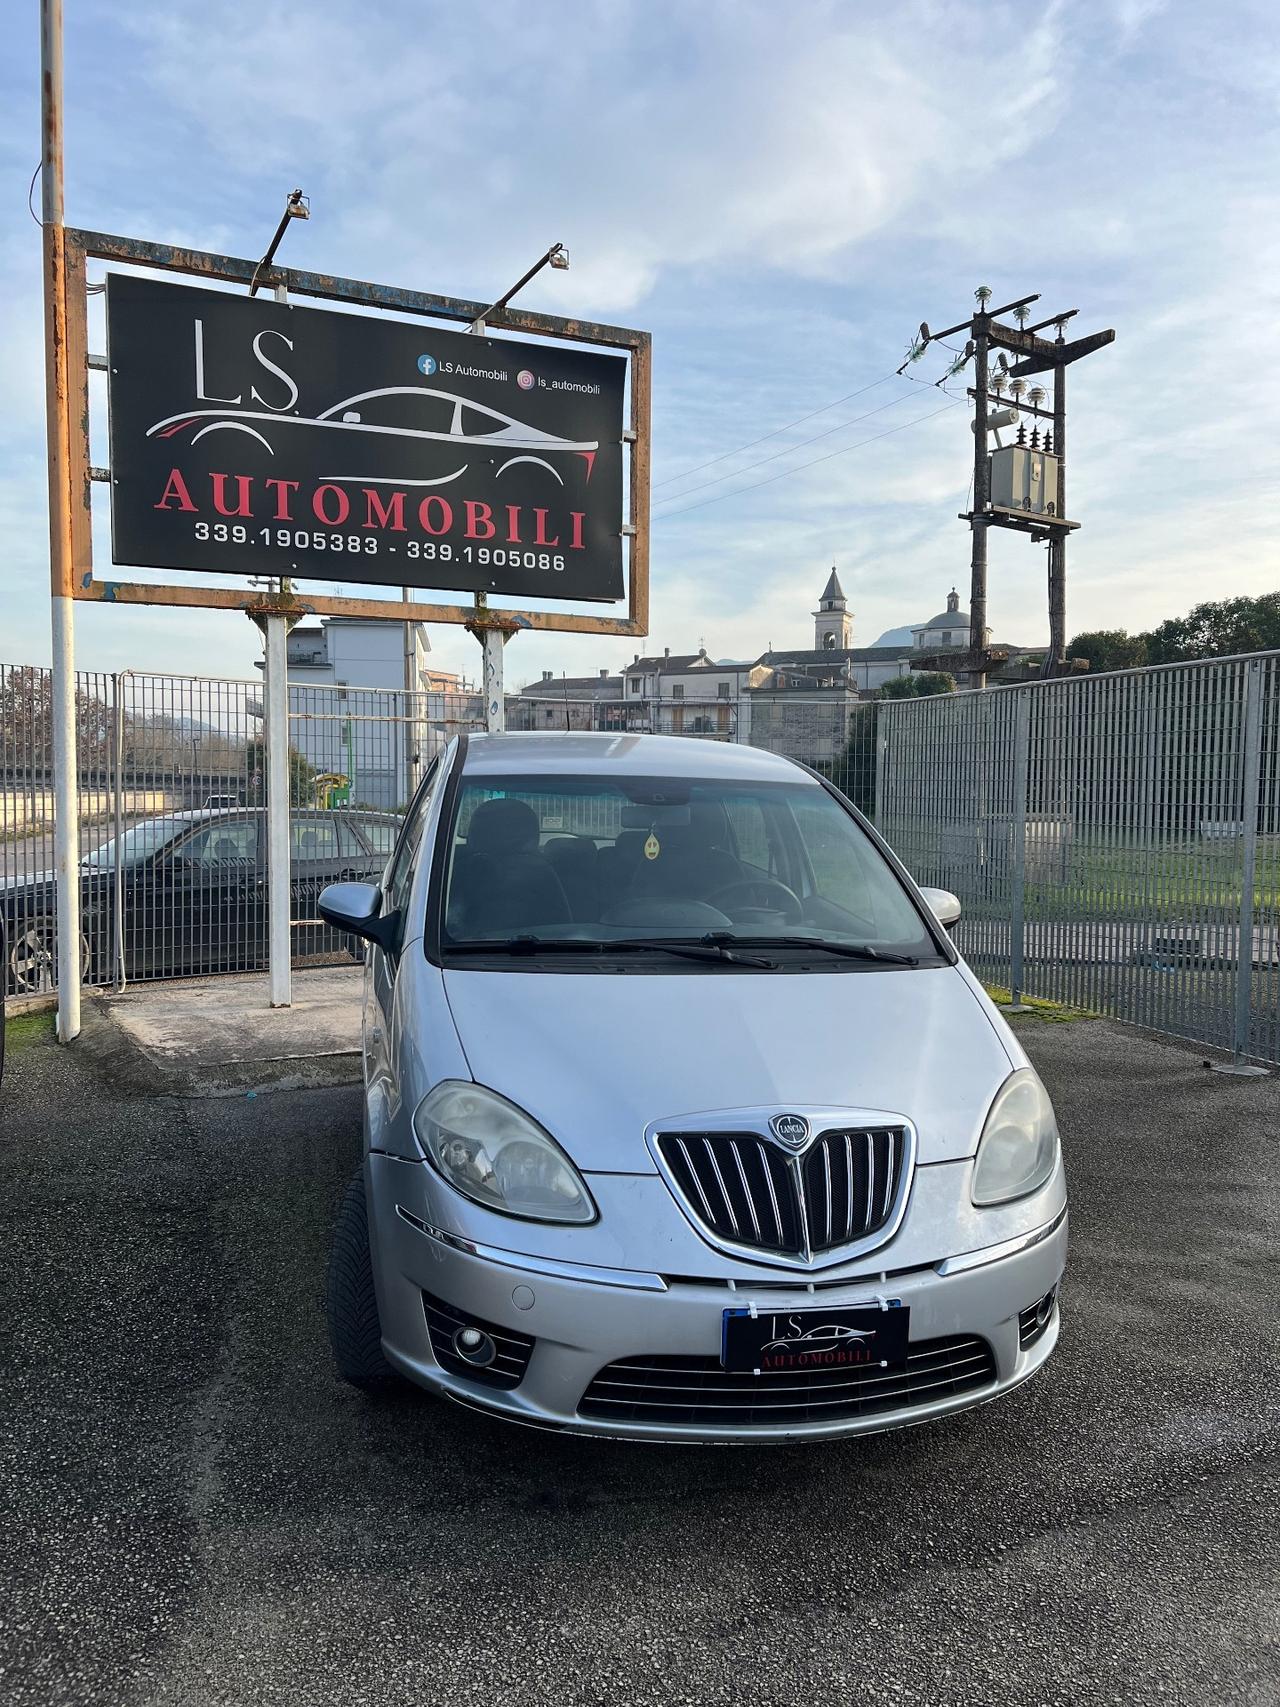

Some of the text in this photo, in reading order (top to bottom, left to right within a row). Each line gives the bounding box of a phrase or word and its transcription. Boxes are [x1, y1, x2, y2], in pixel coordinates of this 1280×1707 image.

[439, 361, 508, 381] LS Automobili
[538, 376, 600, 394] ls_automobili
[153, 468, 586, 549] AUTOMOBILI
[194, 522, 378, 554] 339.1905383
[407, 541, 565, 571] 339.1905086
[780, 1124, 804, 1133] LANCIA
[772, 1315, 802, 1340] LS
[762, 1349, 872, 1368] AUTOMOBILI
